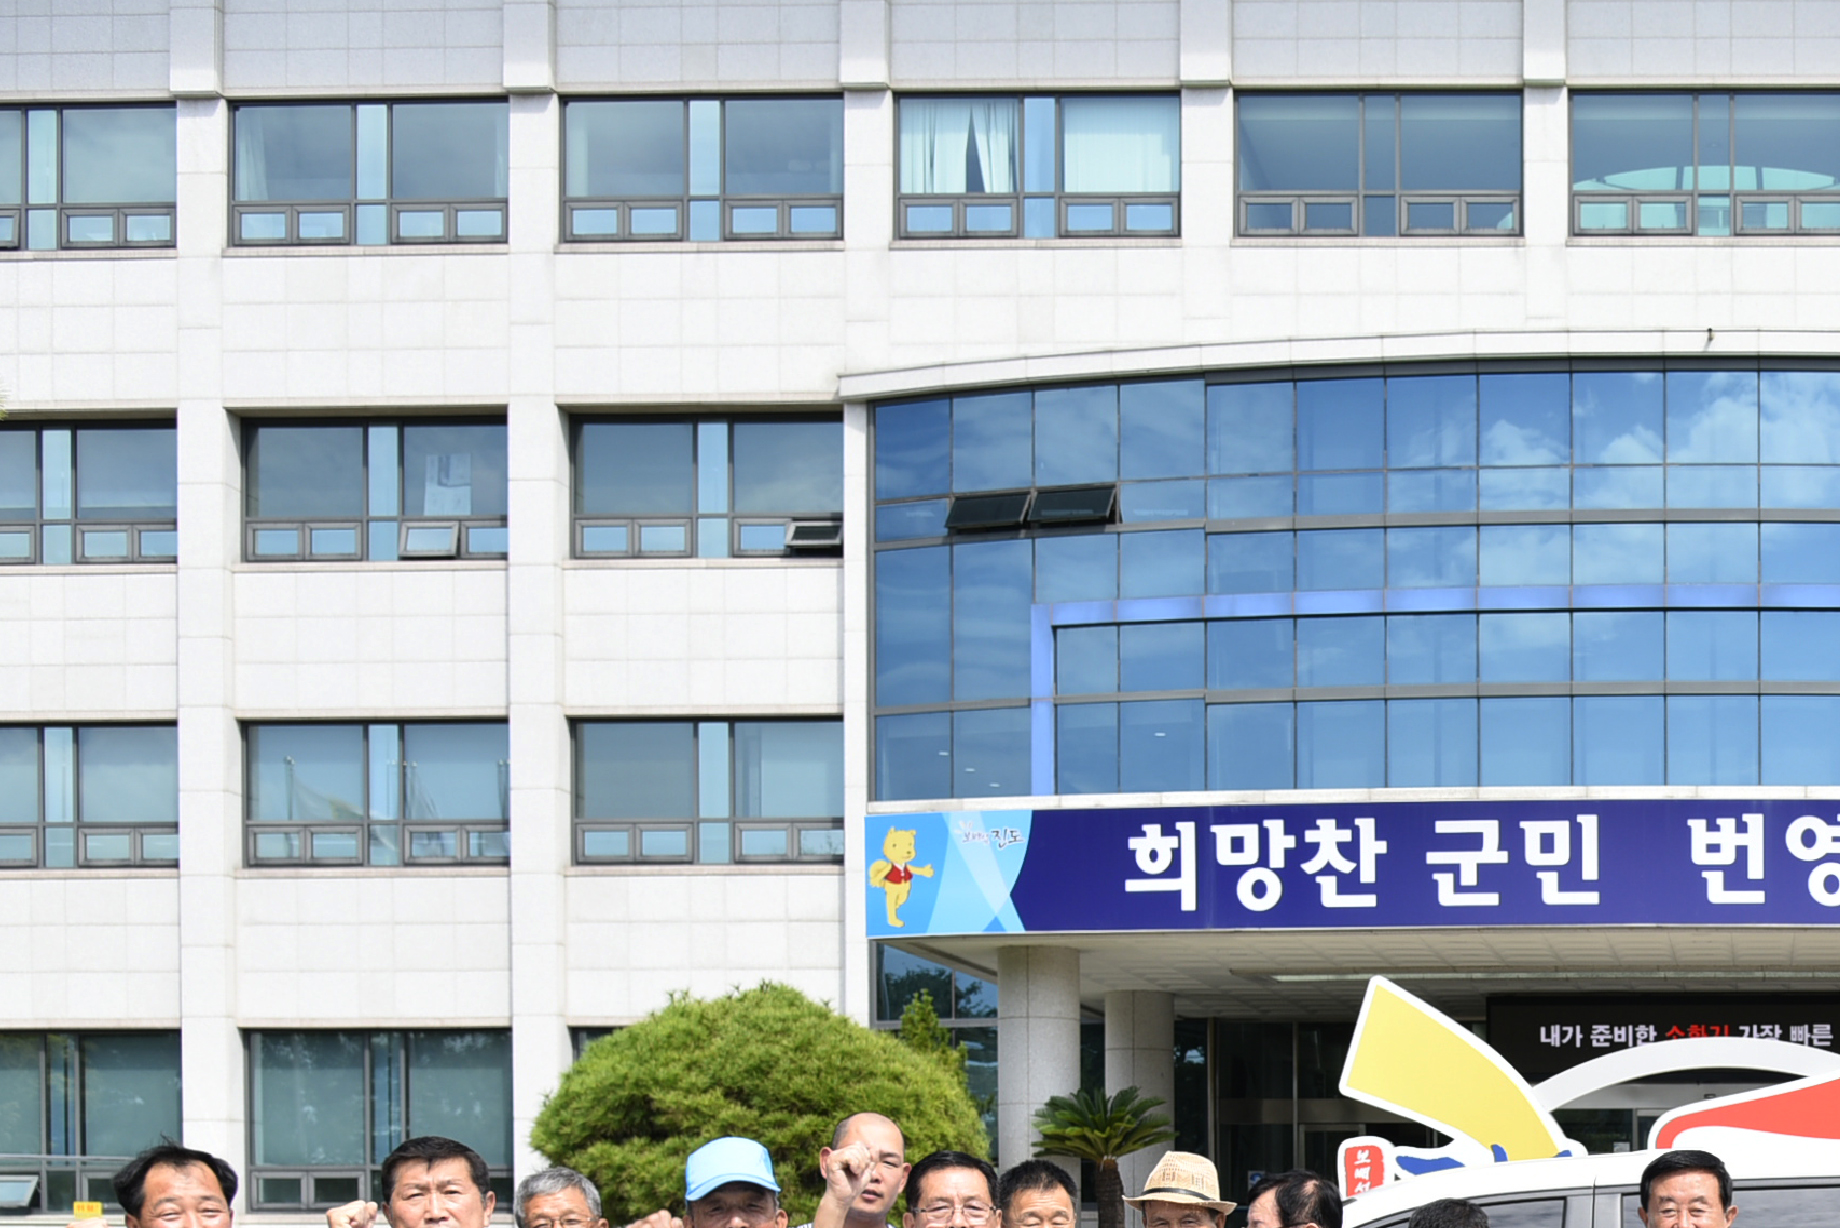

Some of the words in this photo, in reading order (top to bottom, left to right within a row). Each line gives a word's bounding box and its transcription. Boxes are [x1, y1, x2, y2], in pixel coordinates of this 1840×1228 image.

[1124, 816, 1388, 912] 희망찬
[1425, 813, 1602, 907] 군민
[1540, 1024, 1583, 1048] 내가
[1590, 1024, 1657, 1048] 준비한
[1789, 1024, 1834, 1047] 빠른
